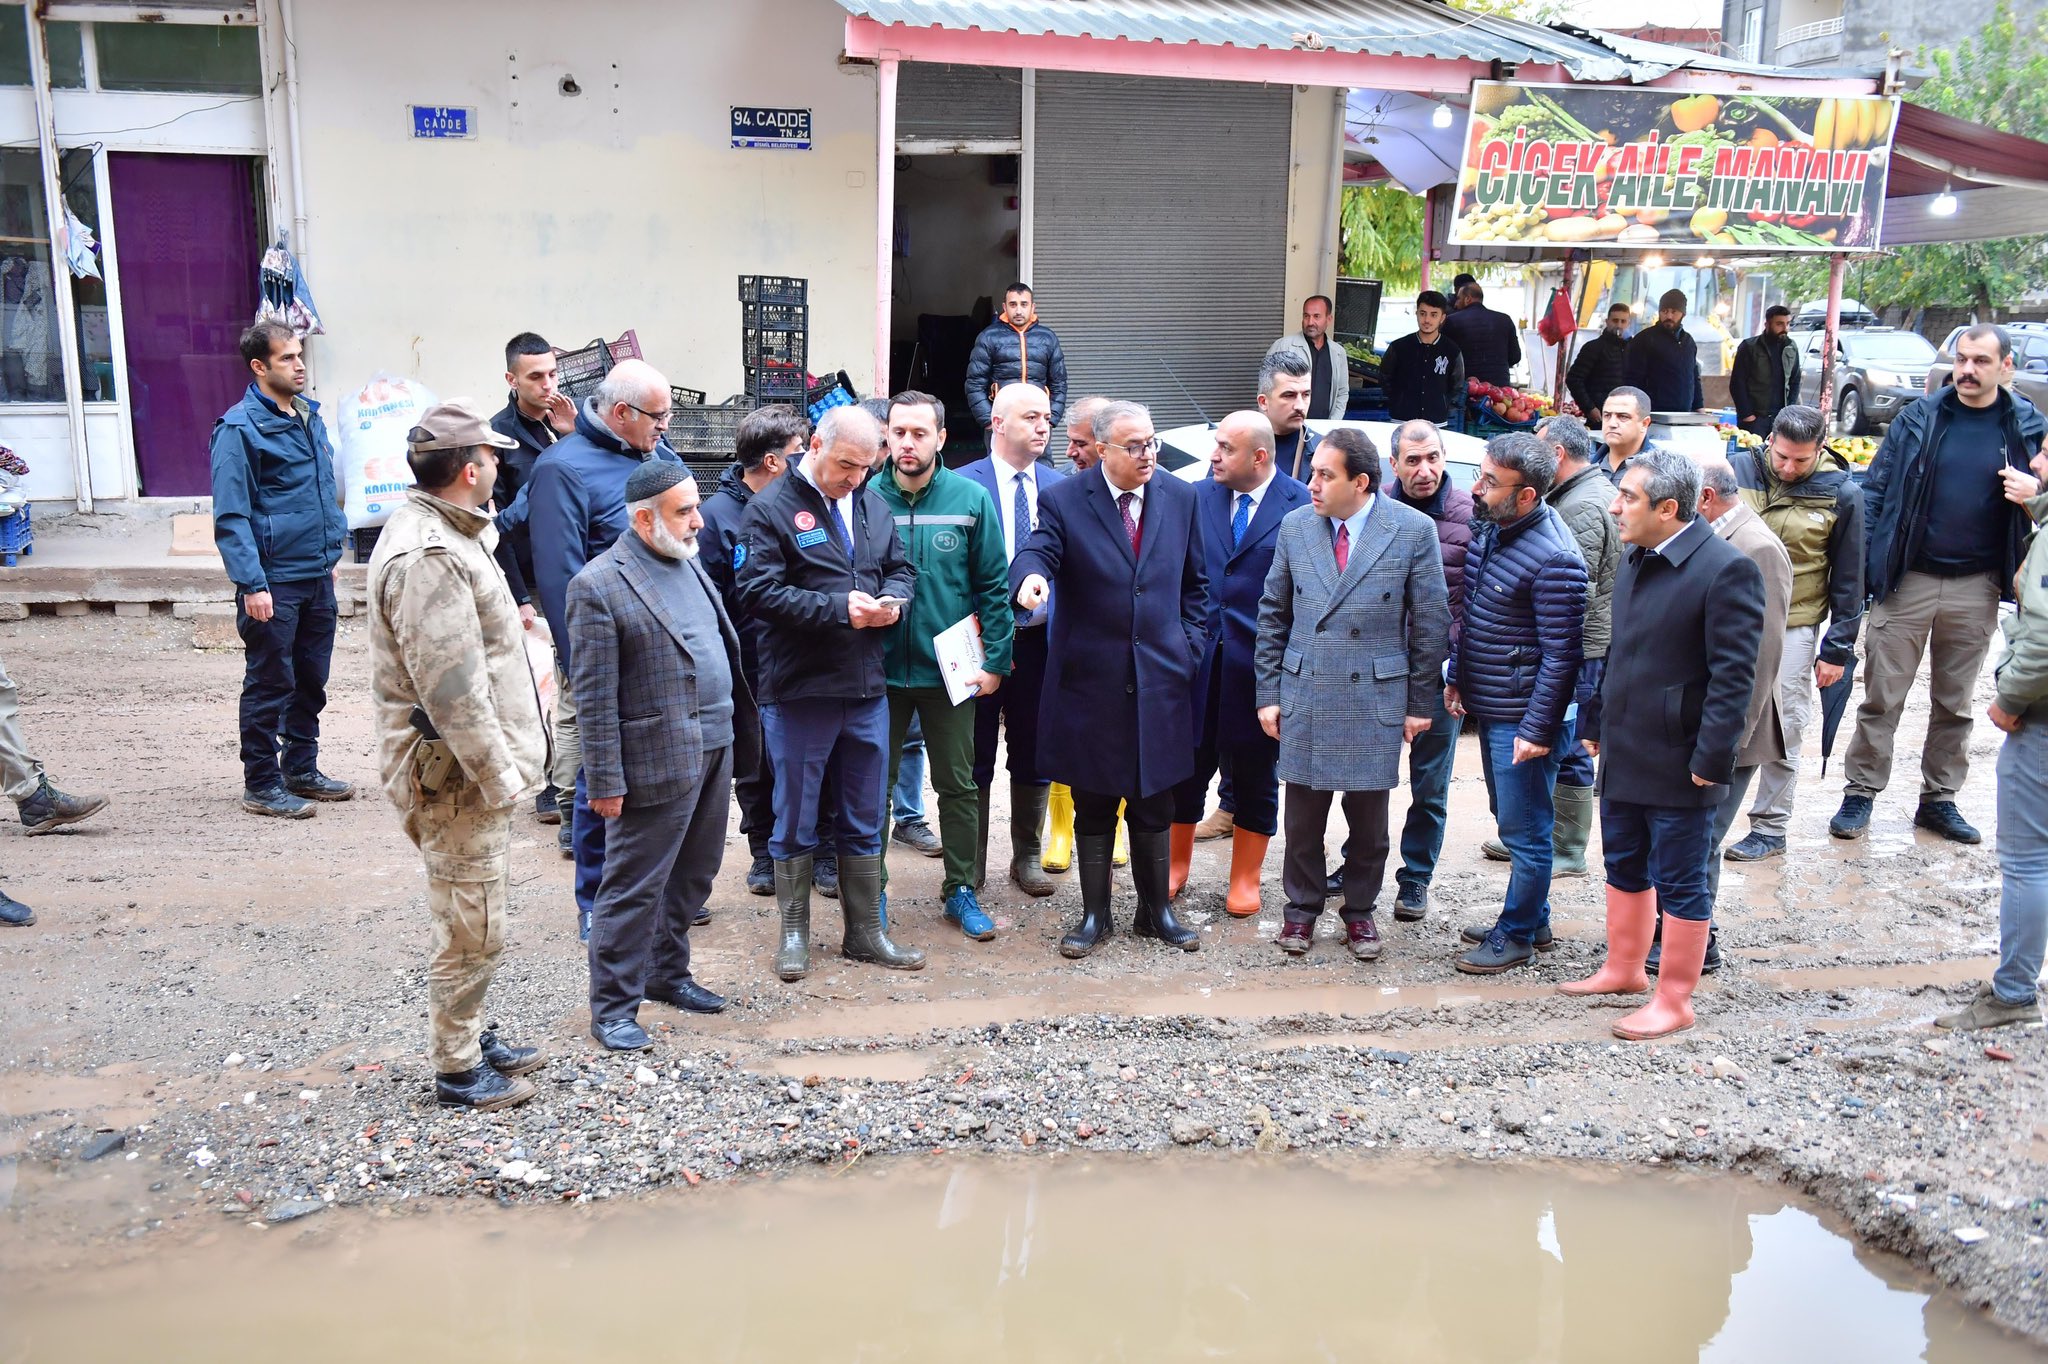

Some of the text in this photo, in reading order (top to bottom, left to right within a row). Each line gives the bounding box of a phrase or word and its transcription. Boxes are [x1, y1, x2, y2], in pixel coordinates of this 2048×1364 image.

[424, 118, 461, 130] CADDE
[1474, 125, 1870, 216] ÇİÇEK AİLE MANAVI
